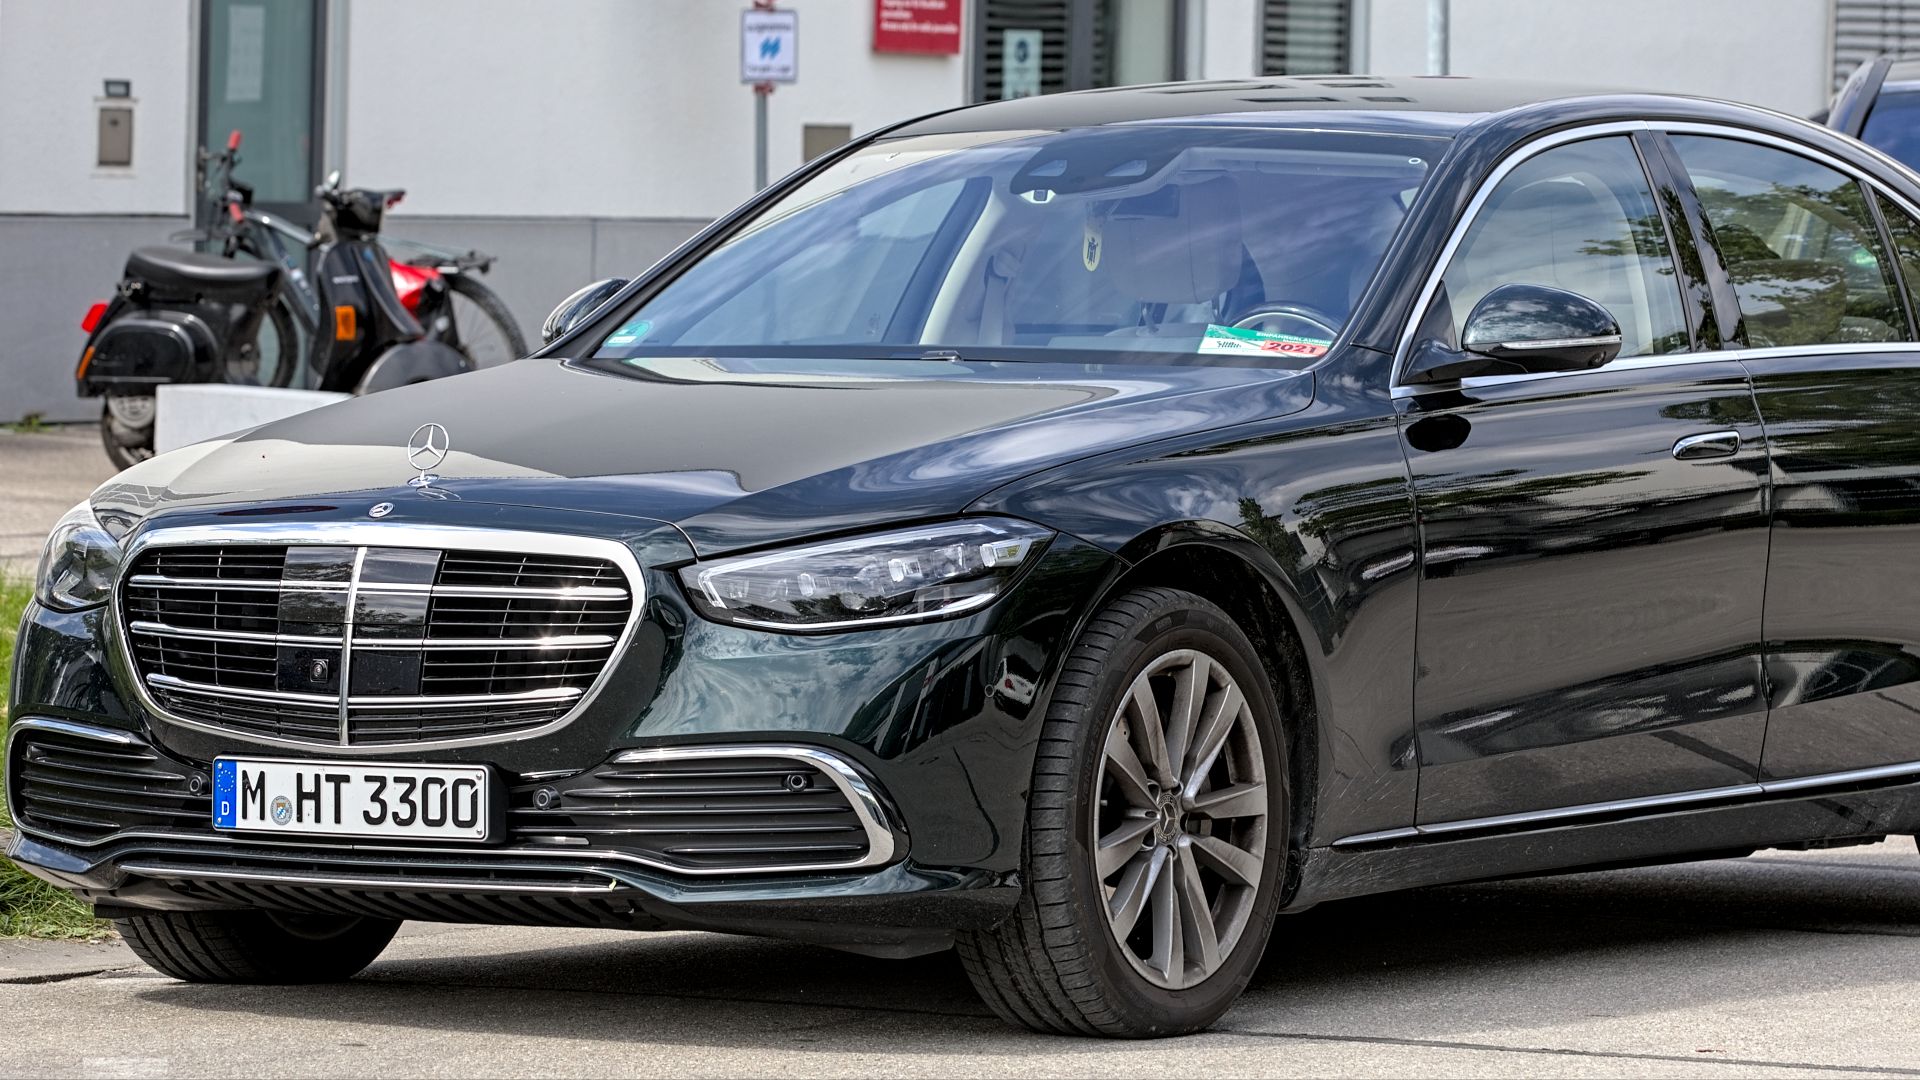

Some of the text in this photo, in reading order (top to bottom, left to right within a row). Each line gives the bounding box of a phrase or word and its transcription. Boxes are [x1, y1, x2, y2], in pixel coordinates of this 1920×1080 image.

[1267, 342, 1317, 354] 2021
[241, 769, 266, 821] M
[296, 772, 351, 825] HT
[362, 774, 479, 829] 3300
[221, 800, 230, 816] D
